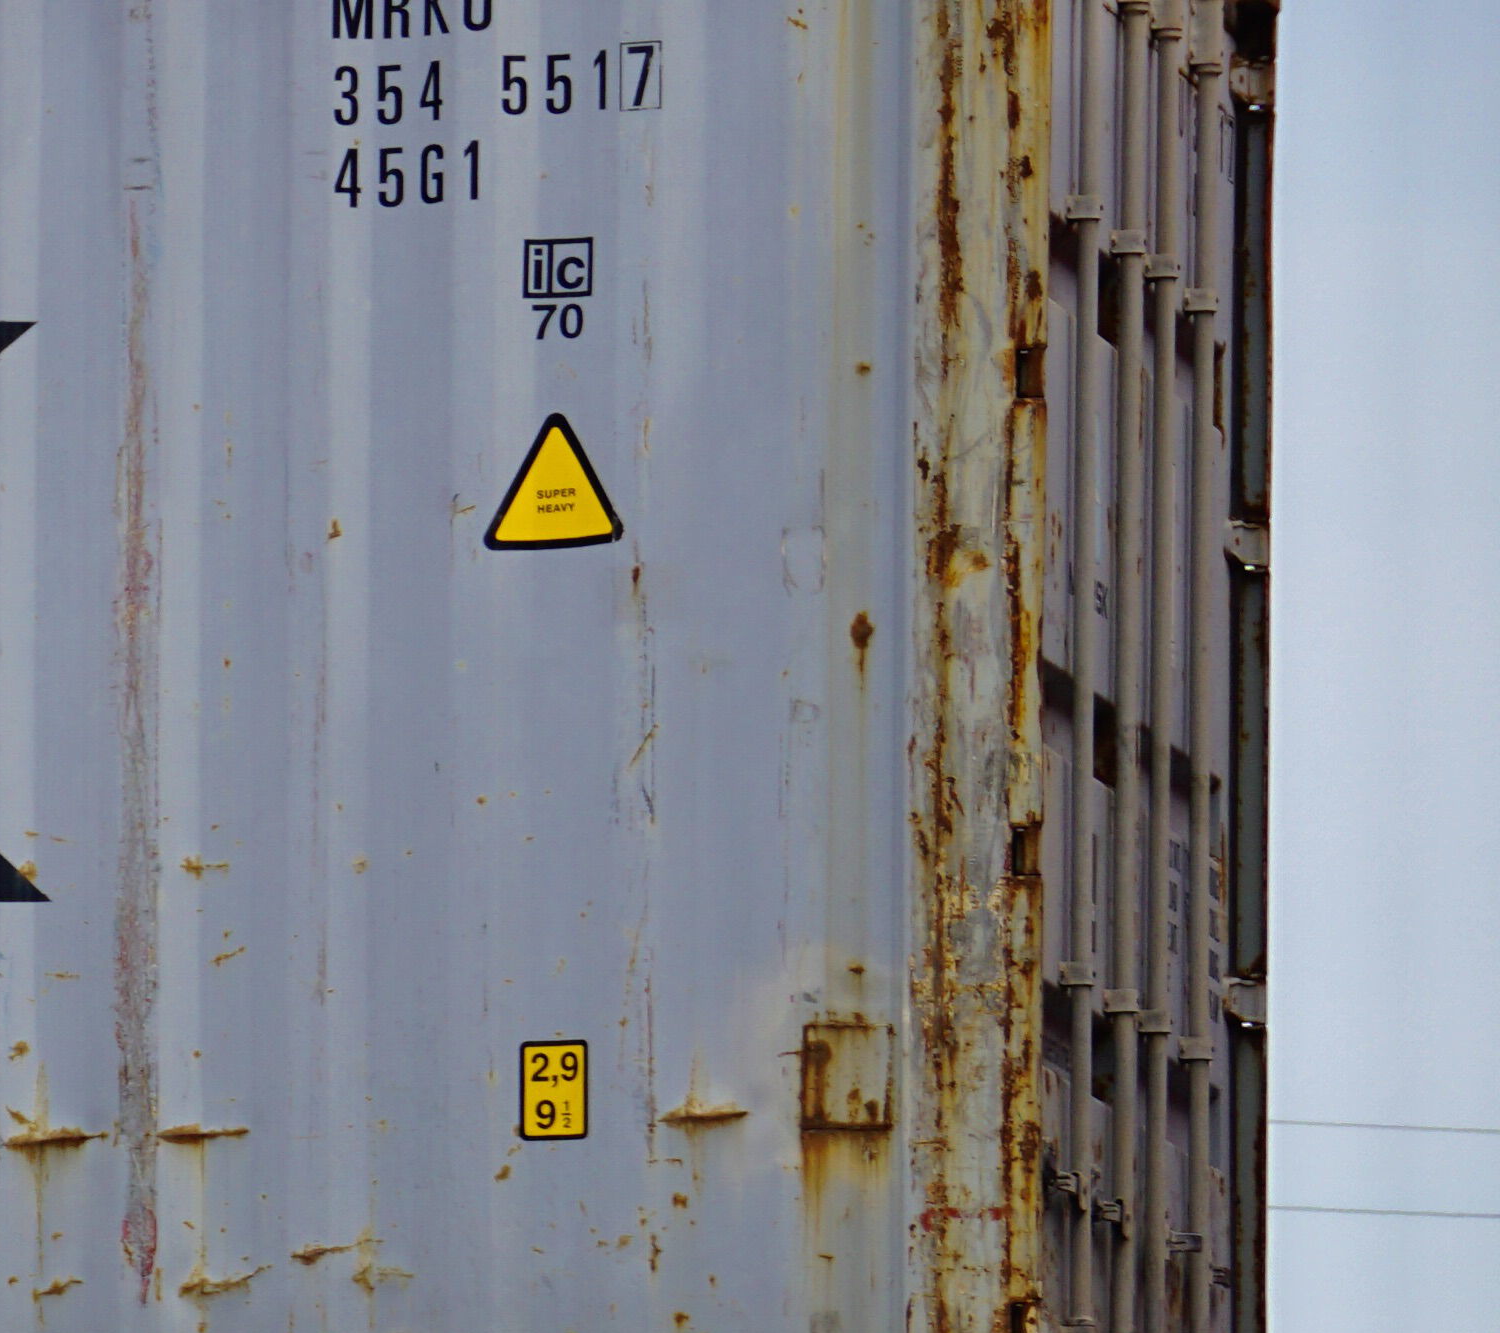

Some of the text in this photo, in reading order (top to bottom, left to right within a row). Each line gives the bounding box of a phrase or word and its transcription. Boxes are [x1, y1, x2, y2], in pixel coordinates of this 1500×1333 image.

[333, 60, 444, 126] 354
[333, 139, 481, 208] 45G1
[530, 303, 584, 340] 70
[536, 487, 576, 500] SUPER
[536, 503, 575, 514] HEAVY
[530, 1051, 579, 1087] 2,9
